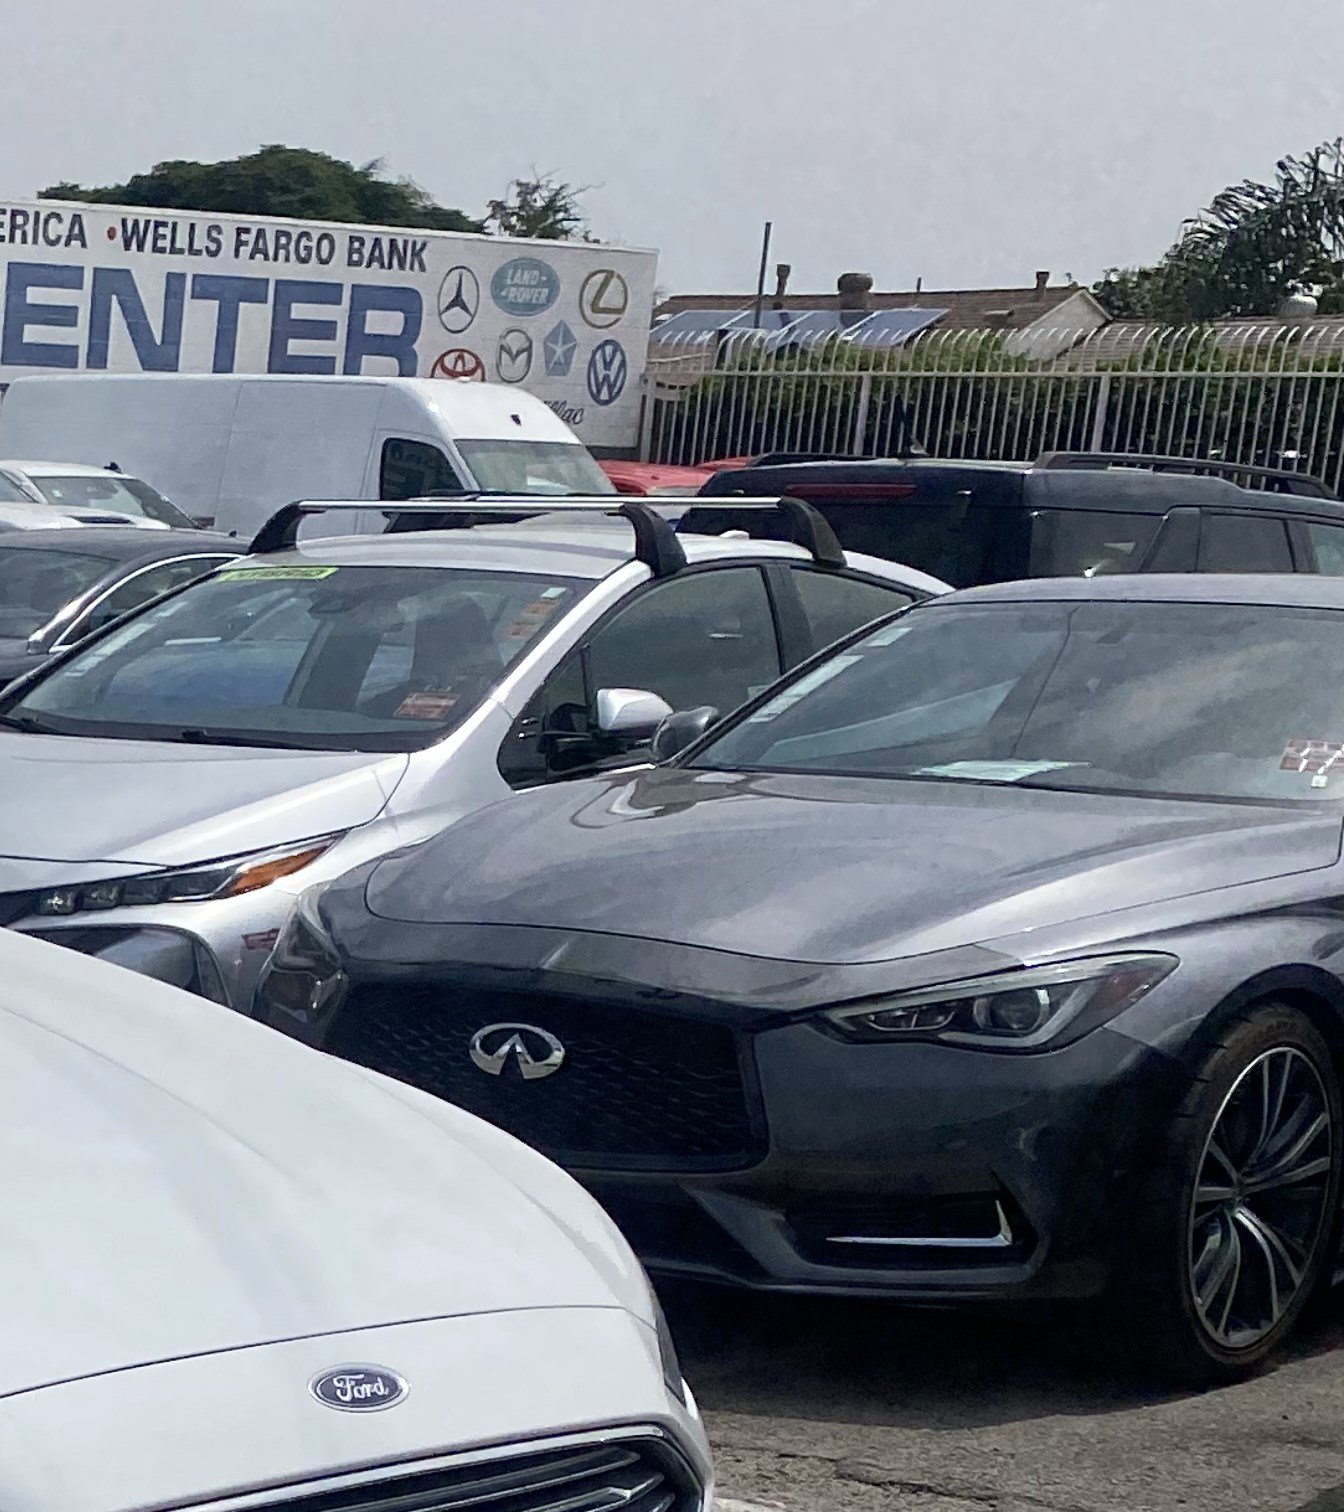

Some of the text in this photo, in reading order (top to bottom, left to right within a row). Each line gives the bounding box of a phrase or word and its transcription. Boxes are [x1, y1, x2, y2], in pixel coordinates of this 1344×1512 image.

[120, 217, 429, 273] WELLS FARGO BANK
[332, 1373, 389, 1402] Ford
